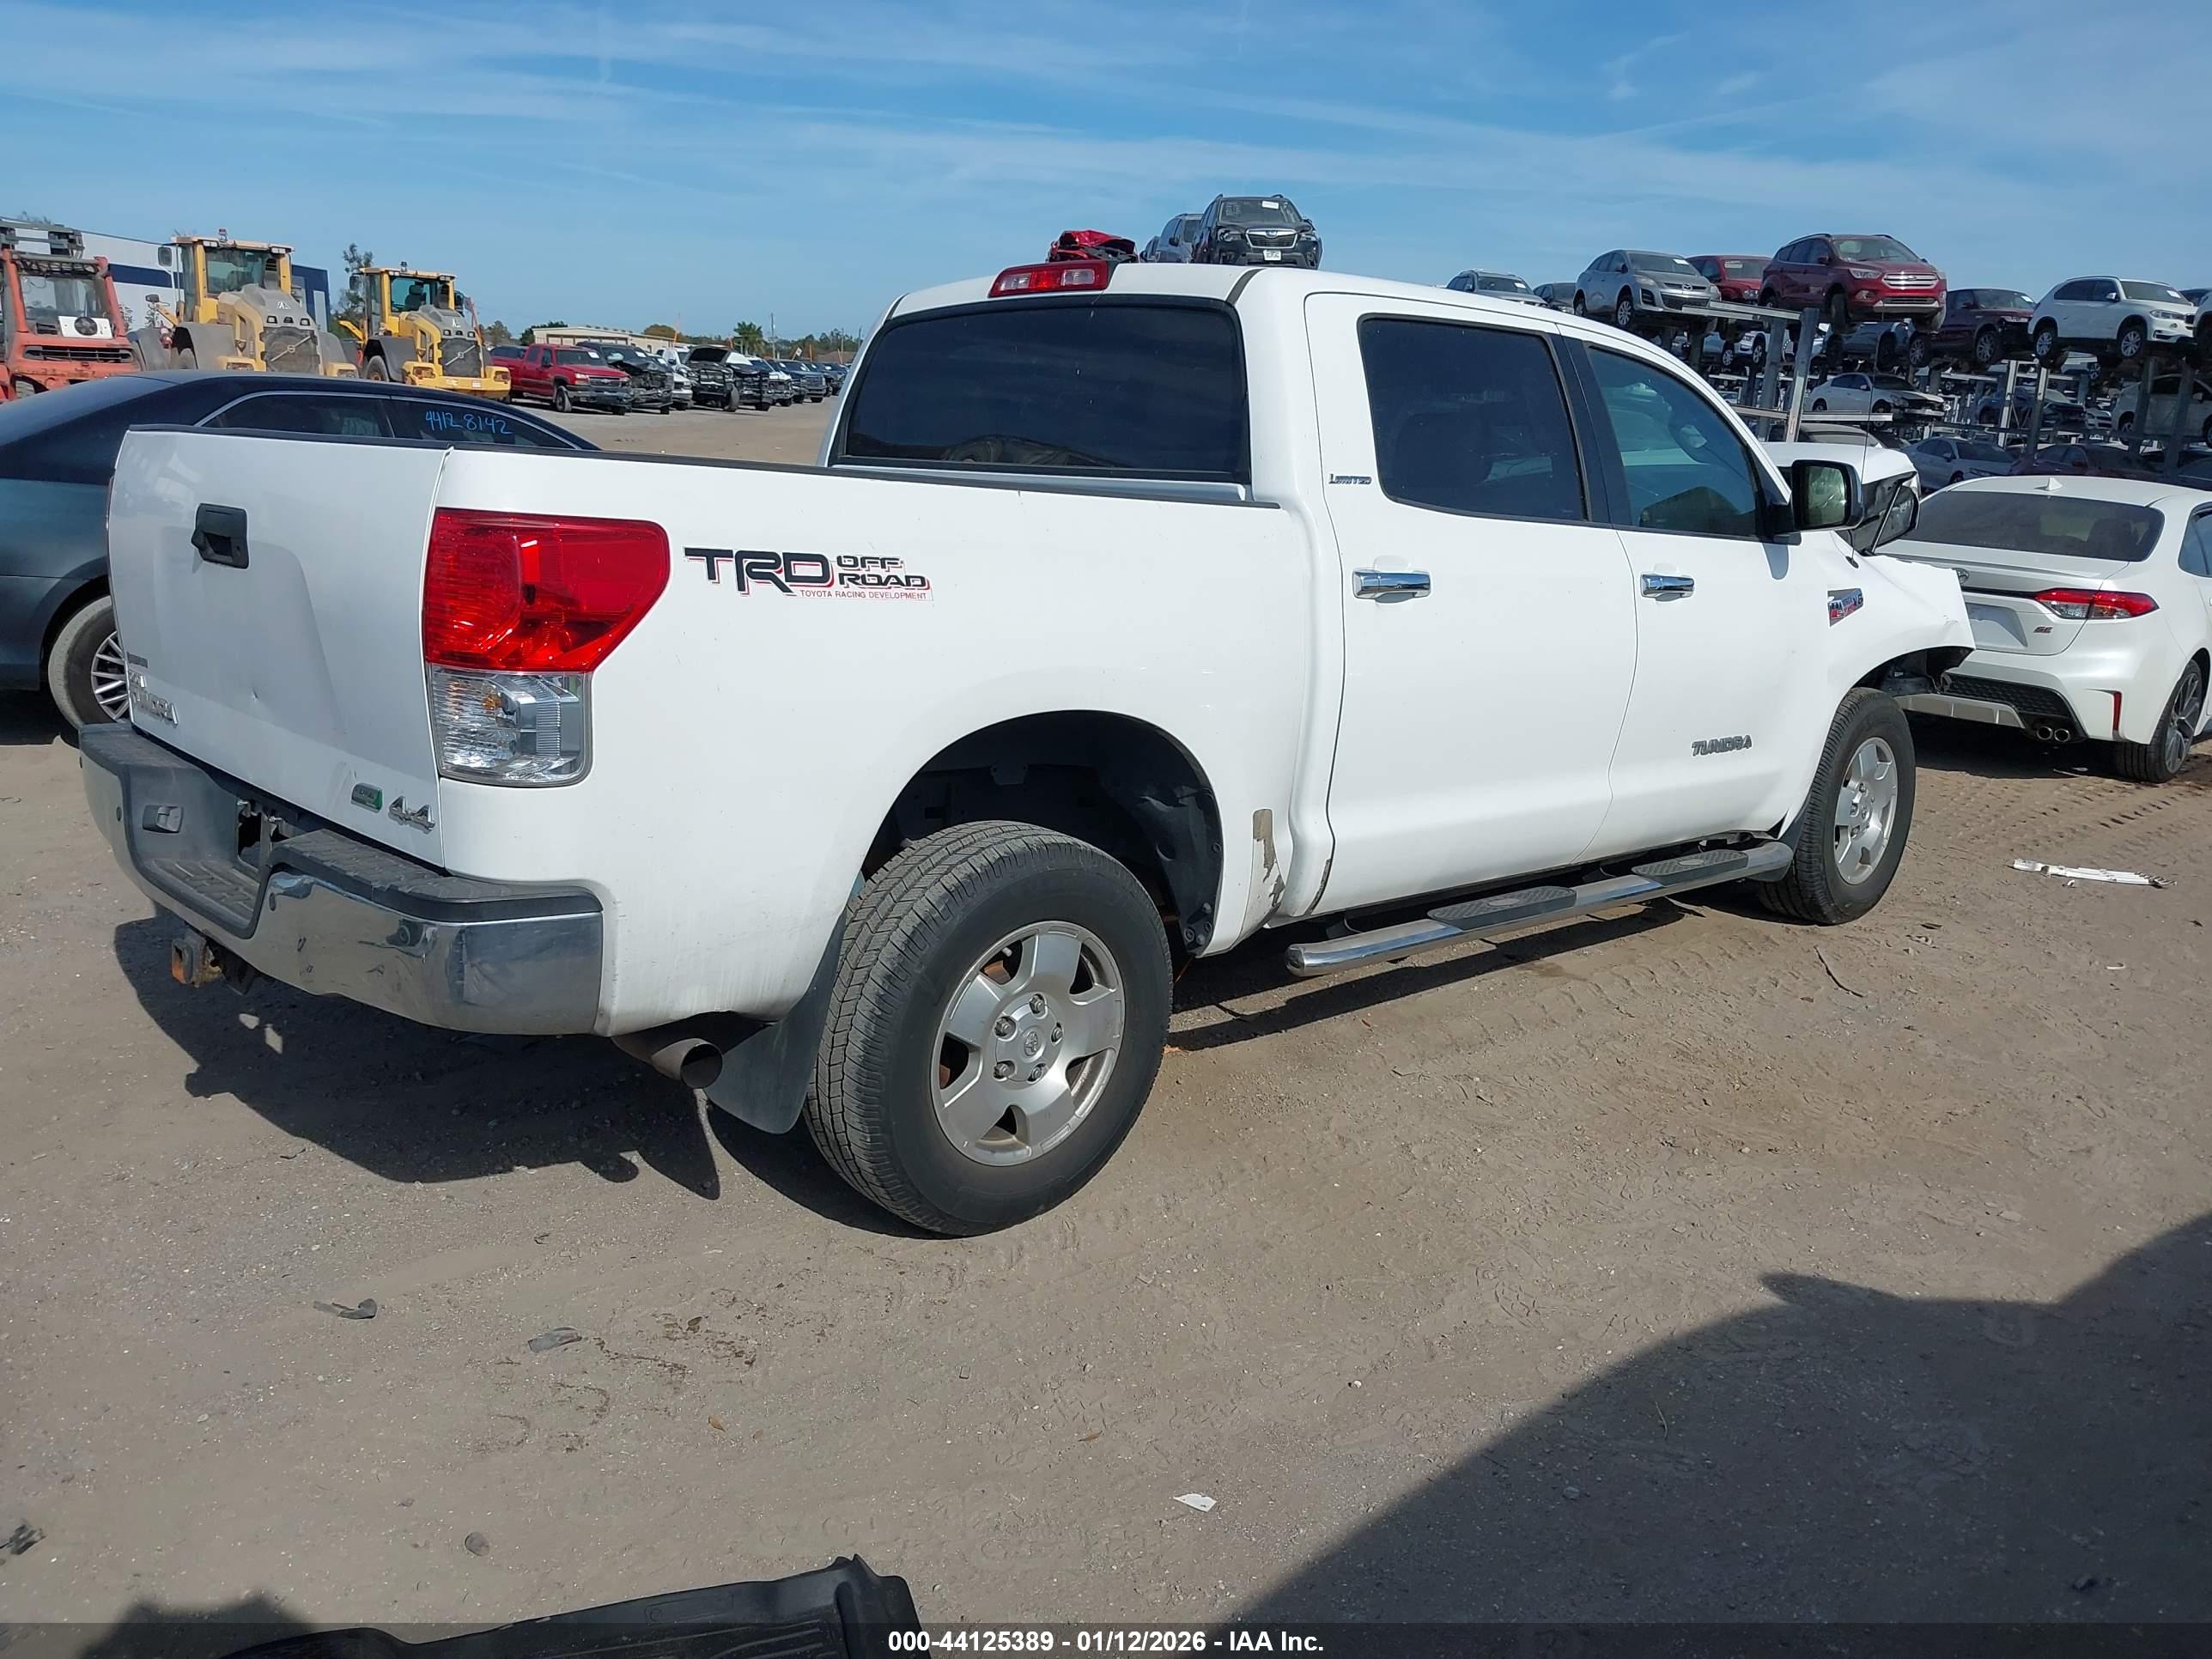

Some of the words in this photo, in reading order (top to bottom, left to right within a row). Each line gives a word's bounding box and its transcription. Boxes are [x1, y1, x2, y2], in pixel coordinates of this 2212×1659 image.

[425, 410, 463, 431] 4412
[464, 413, 514, 434] 8142
[683, 546, 835, 596] TRD
[836, 555, 903, 571] OFF
[838, 573, 931, 590] ROAD
[800, 589, 833, 599] TOYOTA
[835, 591, 867, 599] RACING
[867, 592, 927, 600] DEVELOPMENT
[1691, 734, 1753, 757] TUNDRA
